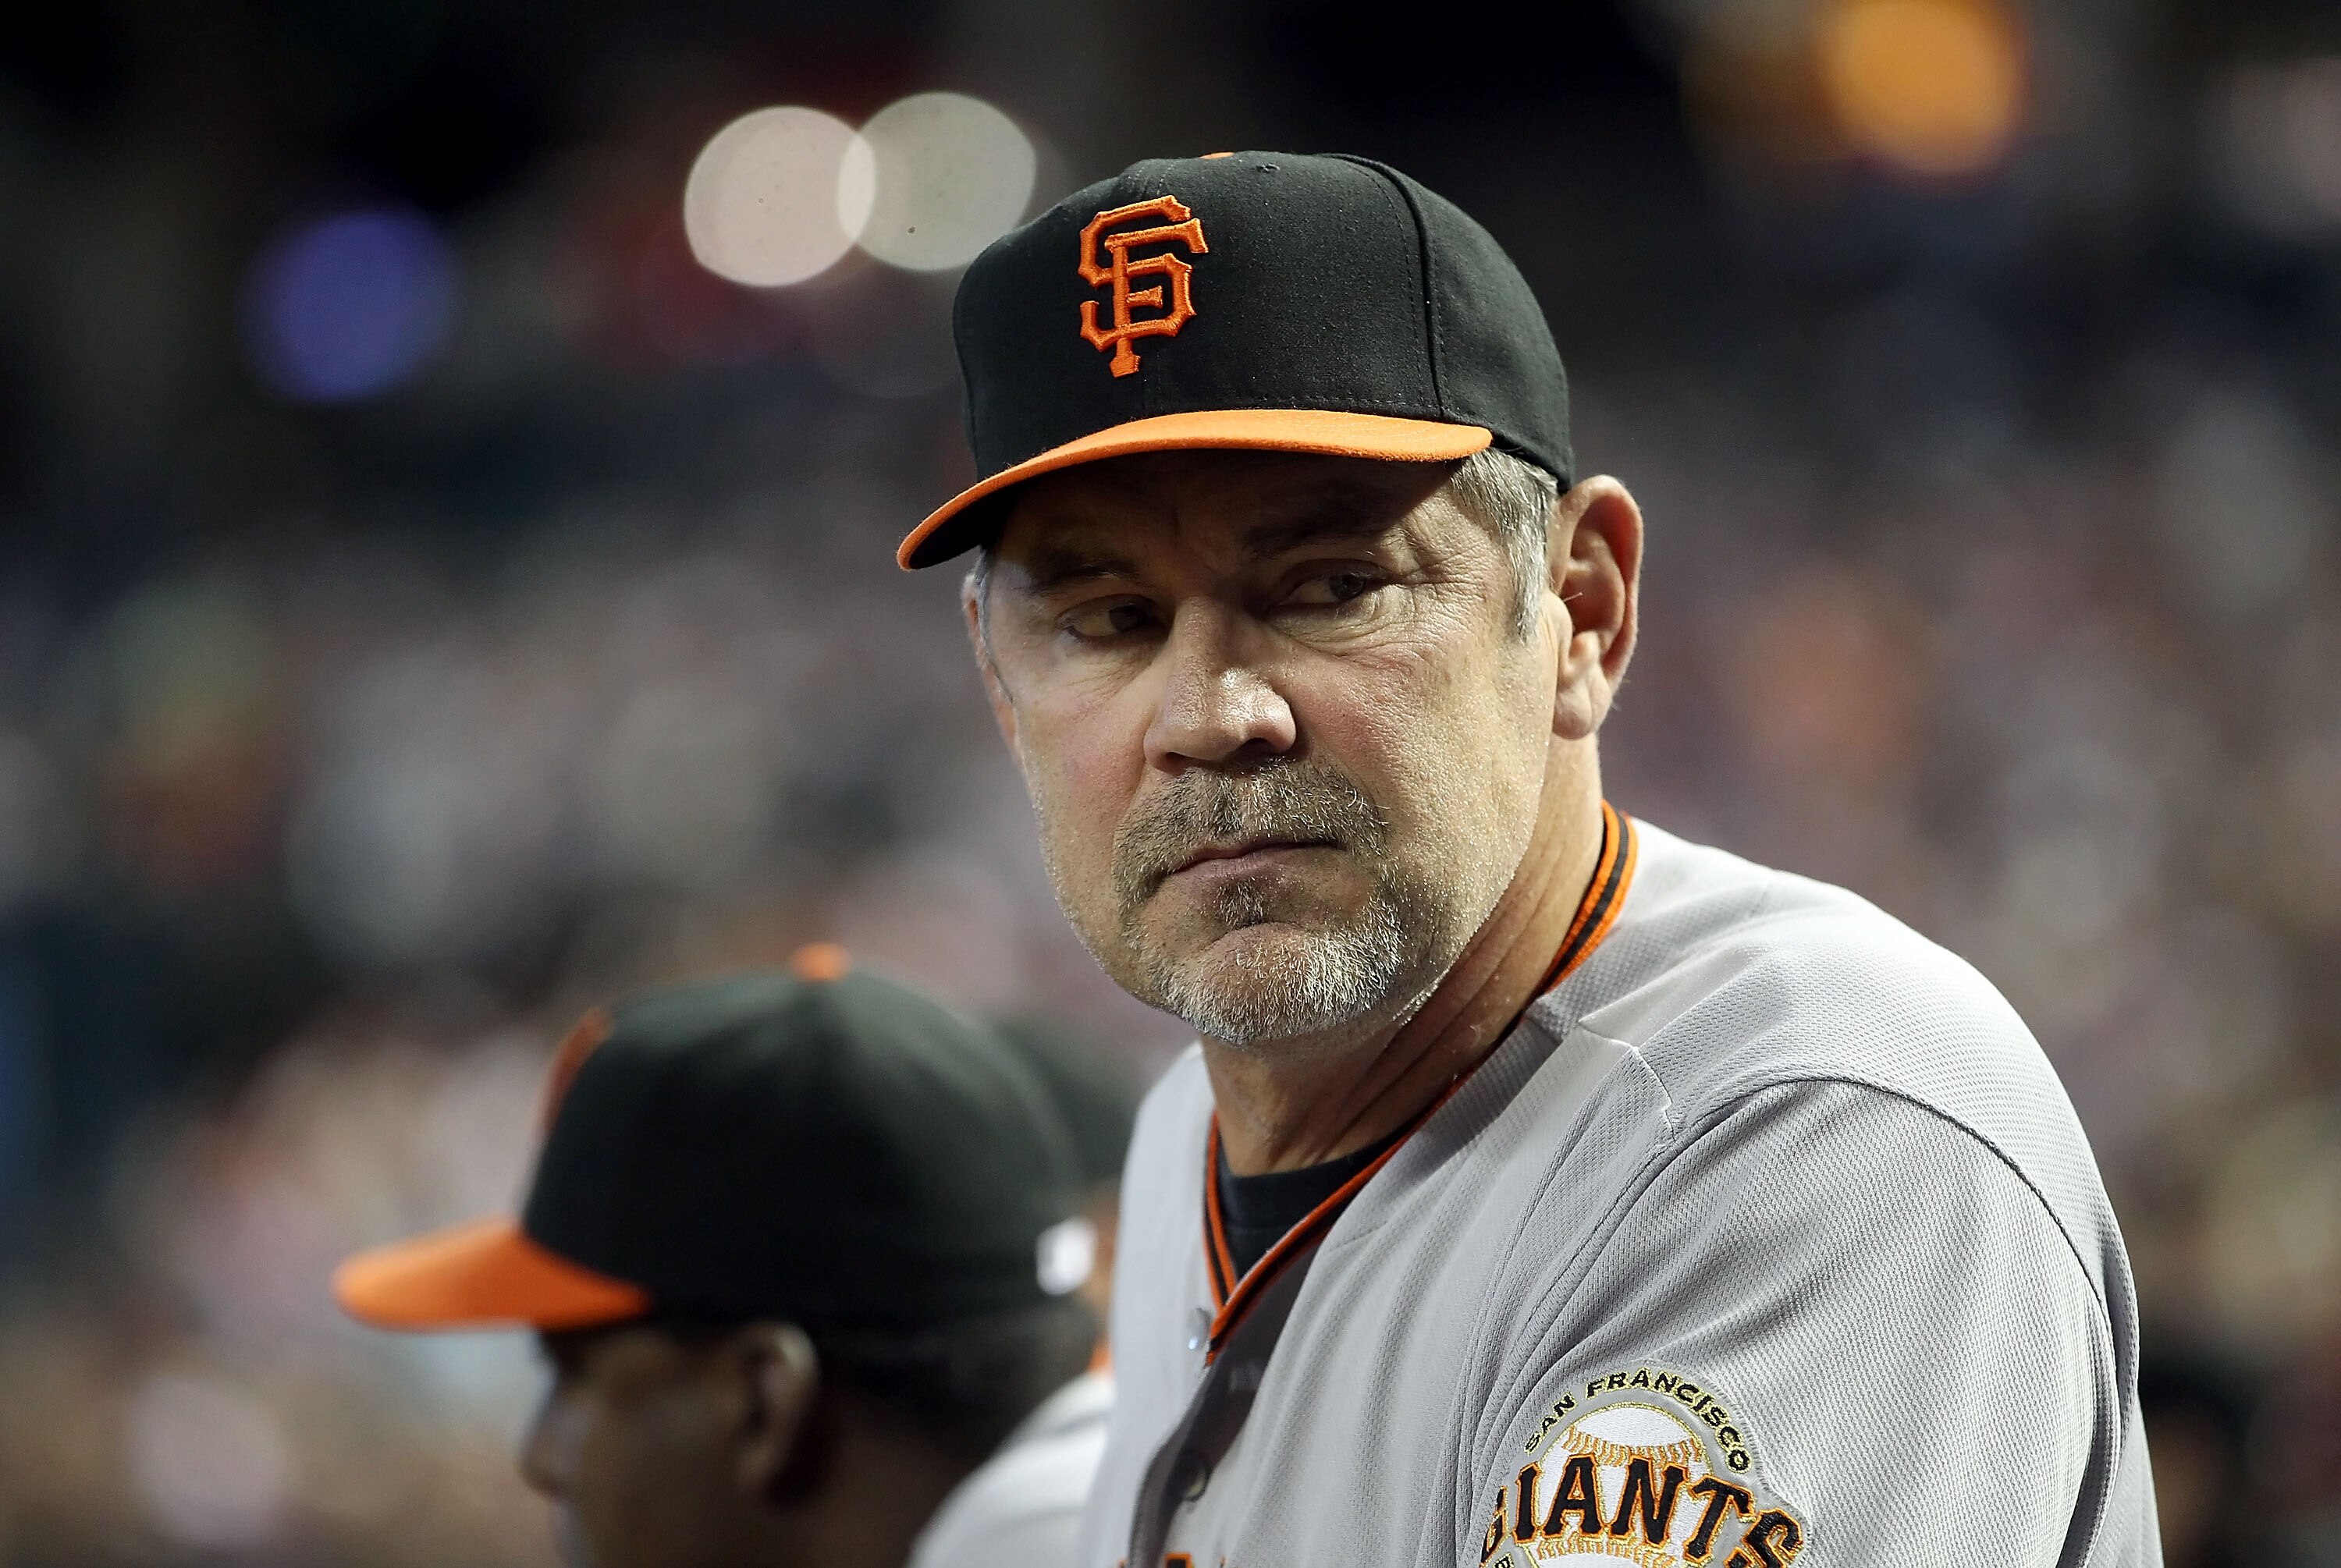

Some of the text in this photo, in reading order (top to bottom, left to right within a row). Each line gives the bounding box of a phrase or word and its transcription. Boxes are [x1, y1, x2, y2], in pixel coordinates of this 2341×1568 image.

[1078, 195, 1209, 378] SF
[1525, 1368, 1752, 1473] SAN FRANCISCO
